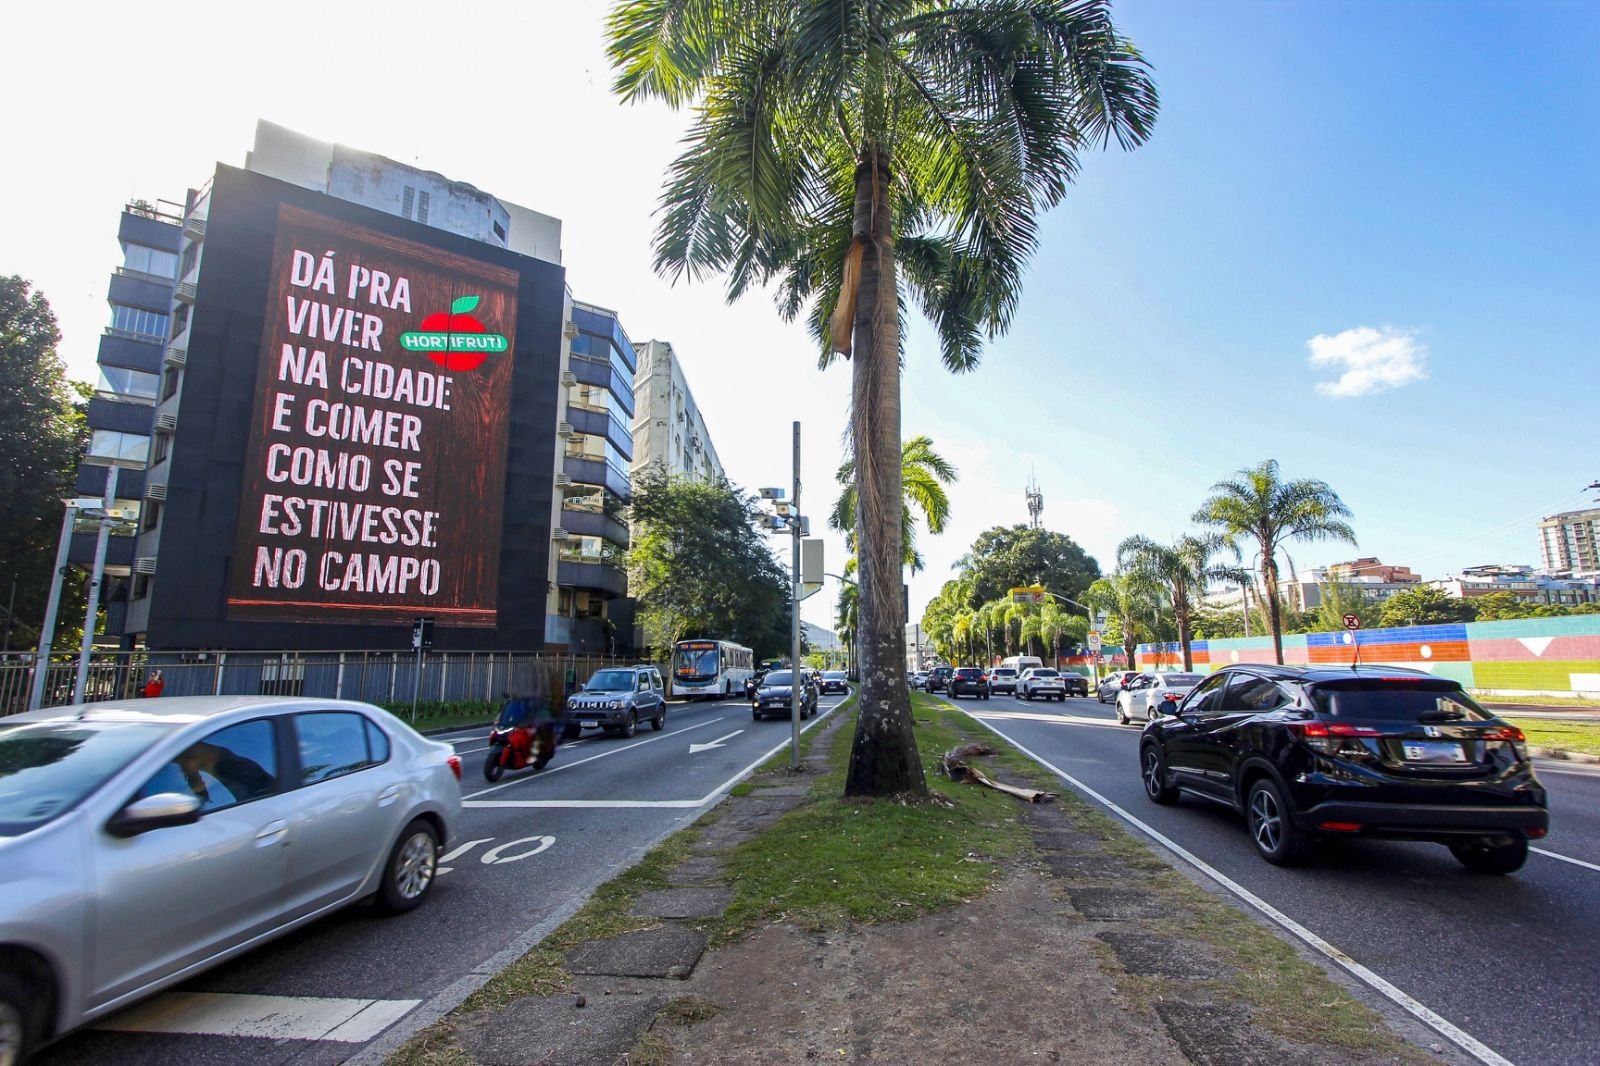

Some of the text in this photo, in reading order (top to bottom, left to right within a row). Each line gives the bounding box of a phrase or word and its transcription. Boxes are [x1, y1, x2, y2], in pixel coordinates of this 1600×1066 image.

[289, 249, 411, 313] DÁ PRA
[286, 296, 383, 352] VIVER
[405, 335, 502, 349] HORTIFRUTI
[278, 343, 453, 411] NA CIDADE
[272, 393, 422, 452] E COMER
[265, 443, 421, 498] COMO SE
[259, 494, 440, 548] ESTIVESSE
[253, 546, 441, 596] NO CAMPO
